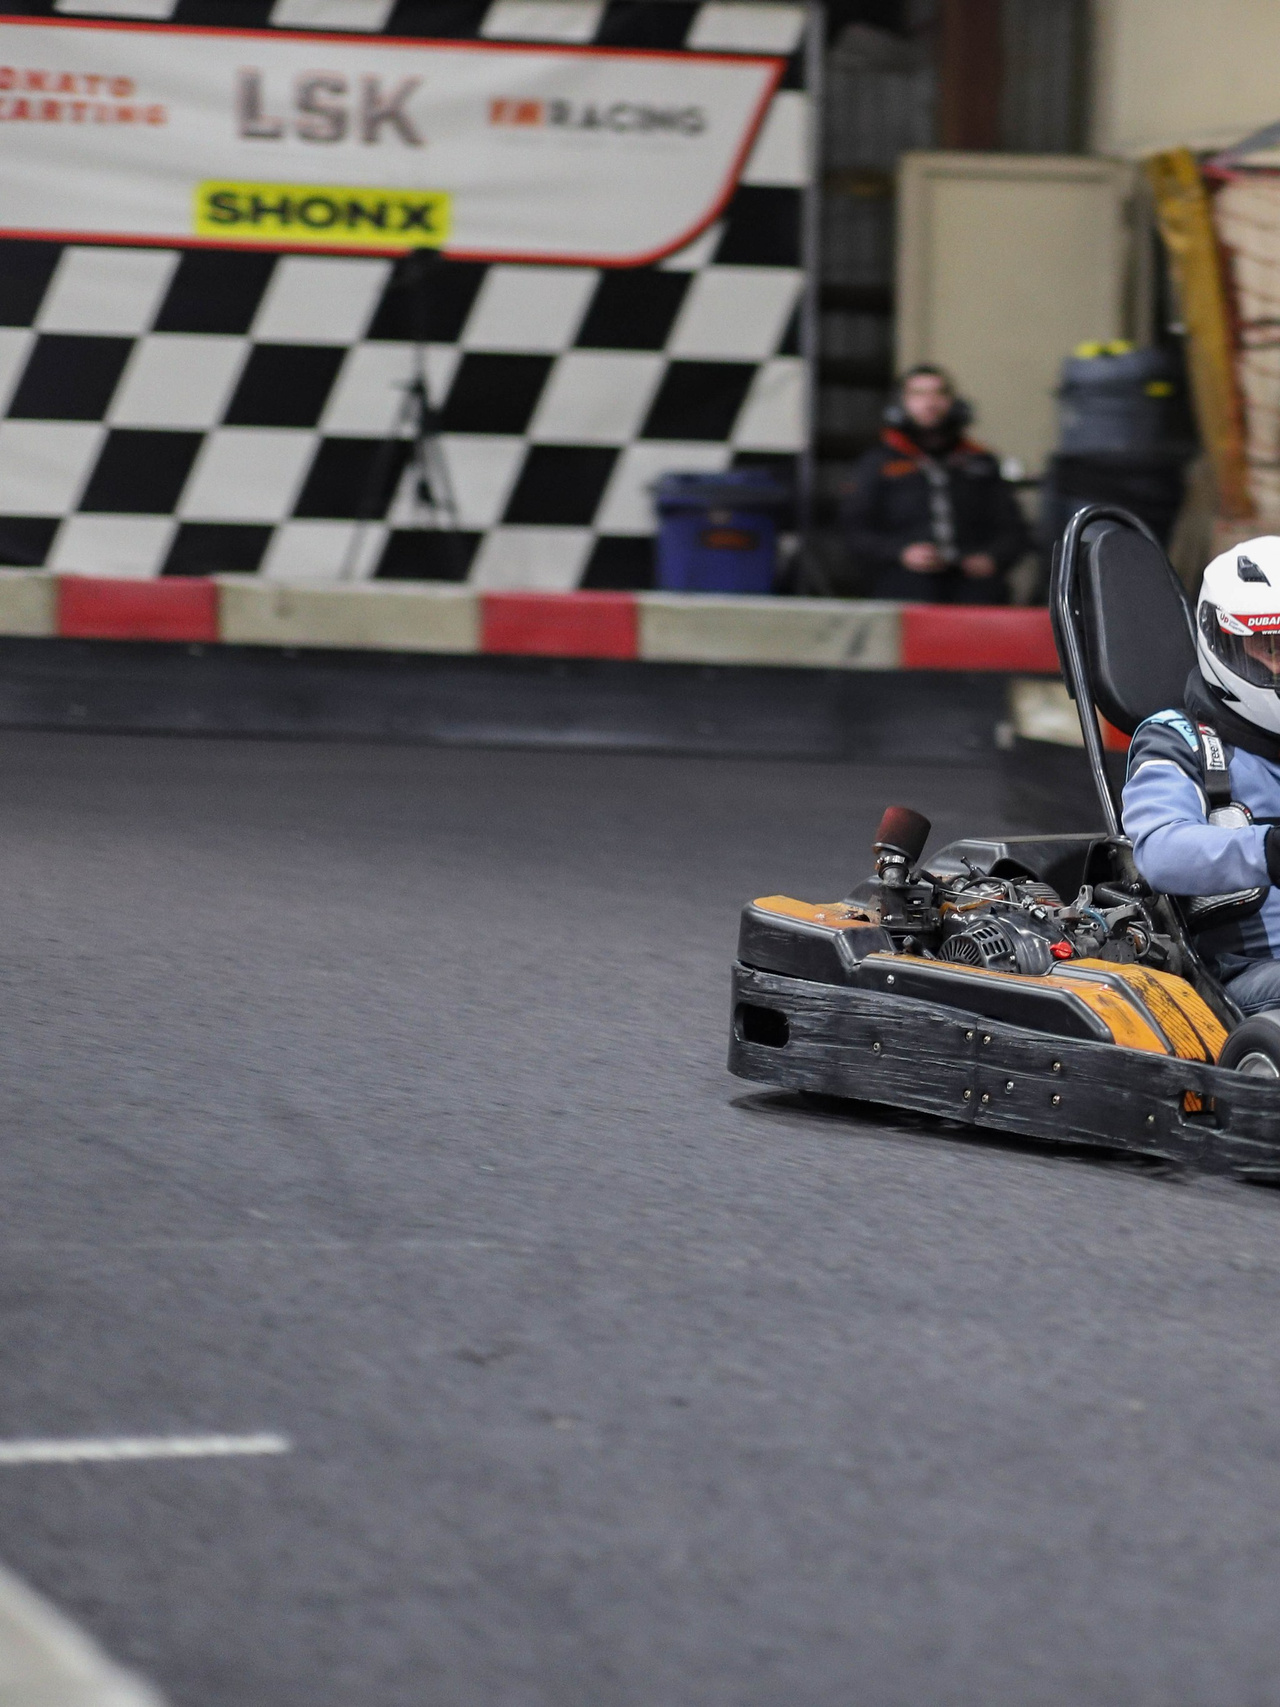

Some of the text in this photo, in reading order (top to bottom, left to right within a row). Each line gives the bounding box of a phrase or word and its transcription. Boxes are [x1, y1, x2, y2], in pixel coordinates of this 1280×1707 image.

[236, 65, 426, 147] LSK
[207, 191, 435, 233] SHONX
[1248, 616, 1280, 626] DUBAI
